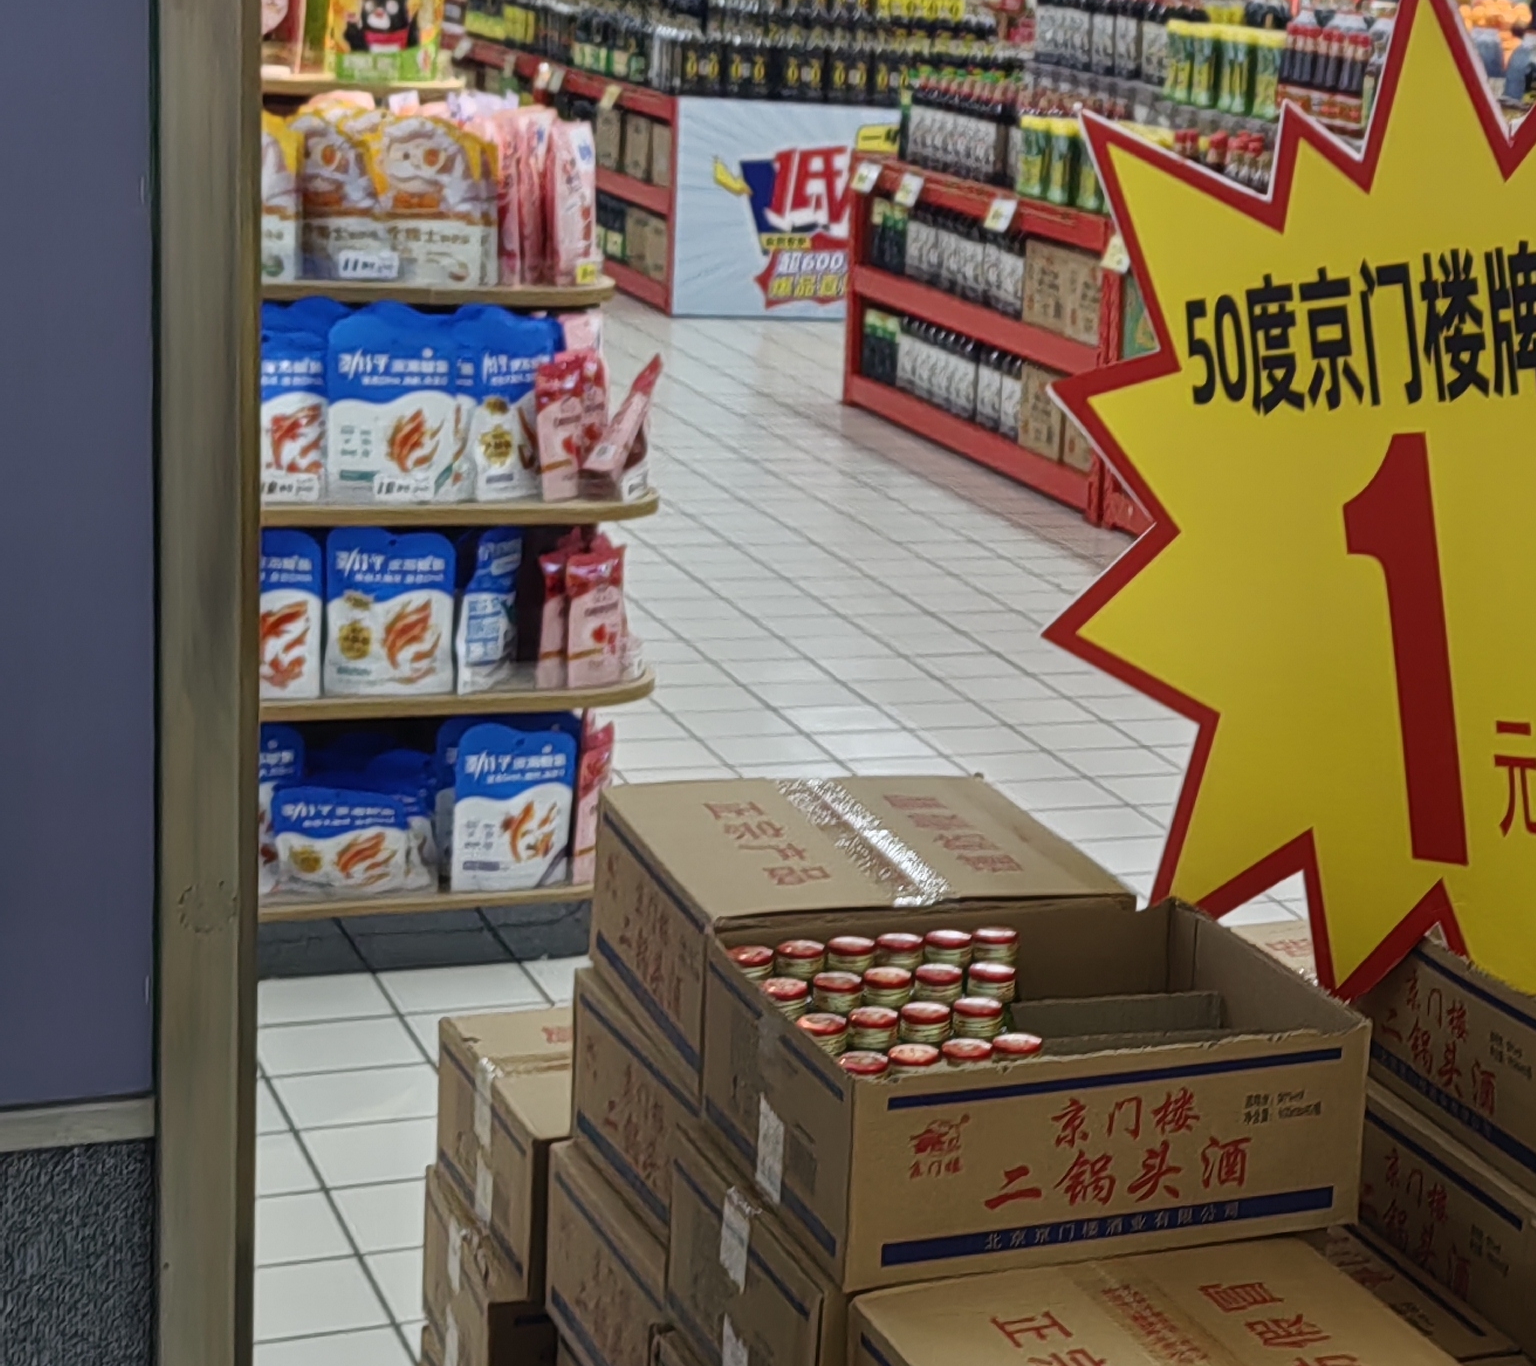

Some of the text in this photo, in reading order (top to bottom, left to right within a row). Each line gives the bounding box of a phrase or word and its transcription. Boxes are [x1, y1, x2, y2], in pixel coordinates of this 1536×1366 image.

[1341, 431, 1469, 866] 1
[1050, 1087, 1201, 1149] 京门楼
[983, 1135, 1253, 1211] 二锅头酒
[983, 1200, 1242, 1252] 北京京门楼酒业有限公司
